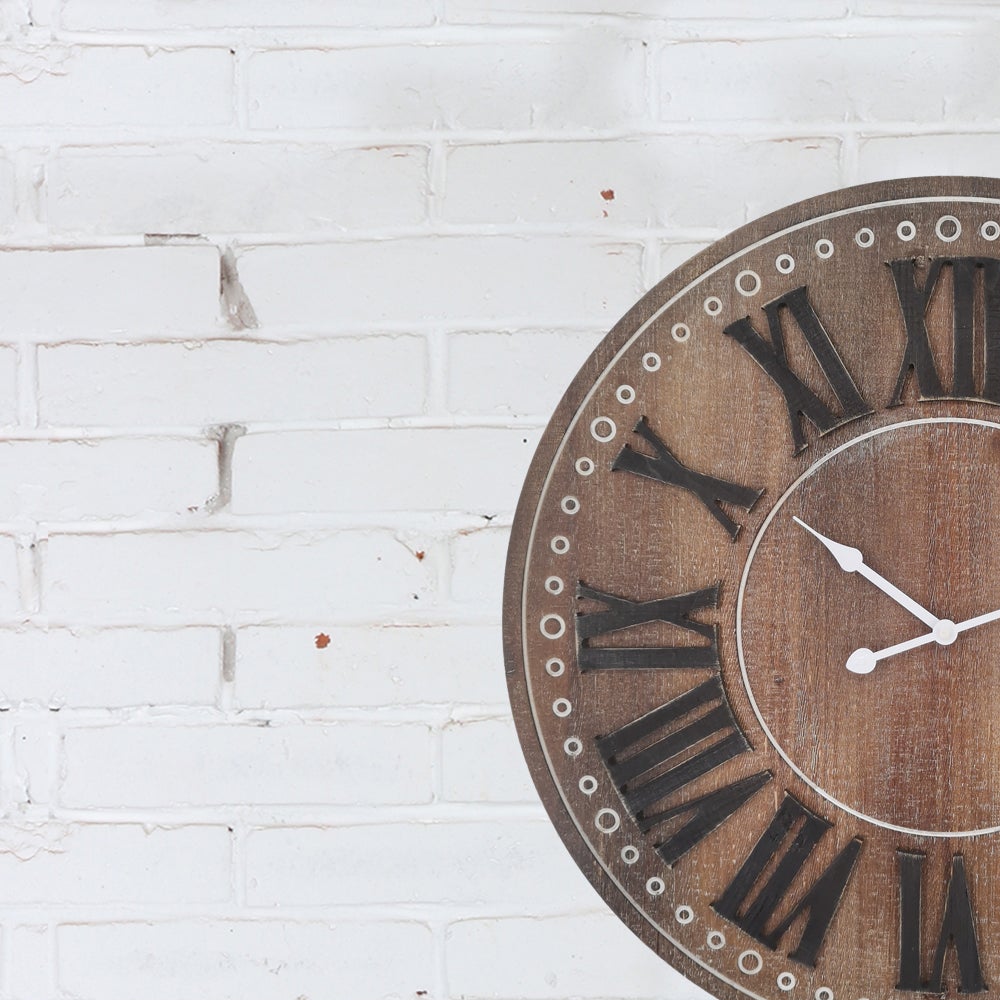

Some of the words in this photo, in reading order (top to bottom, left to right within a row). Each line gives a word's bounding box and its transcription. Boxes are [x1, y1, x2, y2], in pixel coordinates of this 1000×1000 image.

[723, 285, 876, 456] XI
[610, 414, 766, 541] X
[575, 579, 722, 674] IX
[595, 677, 773, 868] VIII
[709, 791, 865, 969] VII
[894, 848, 989, 995] VI
